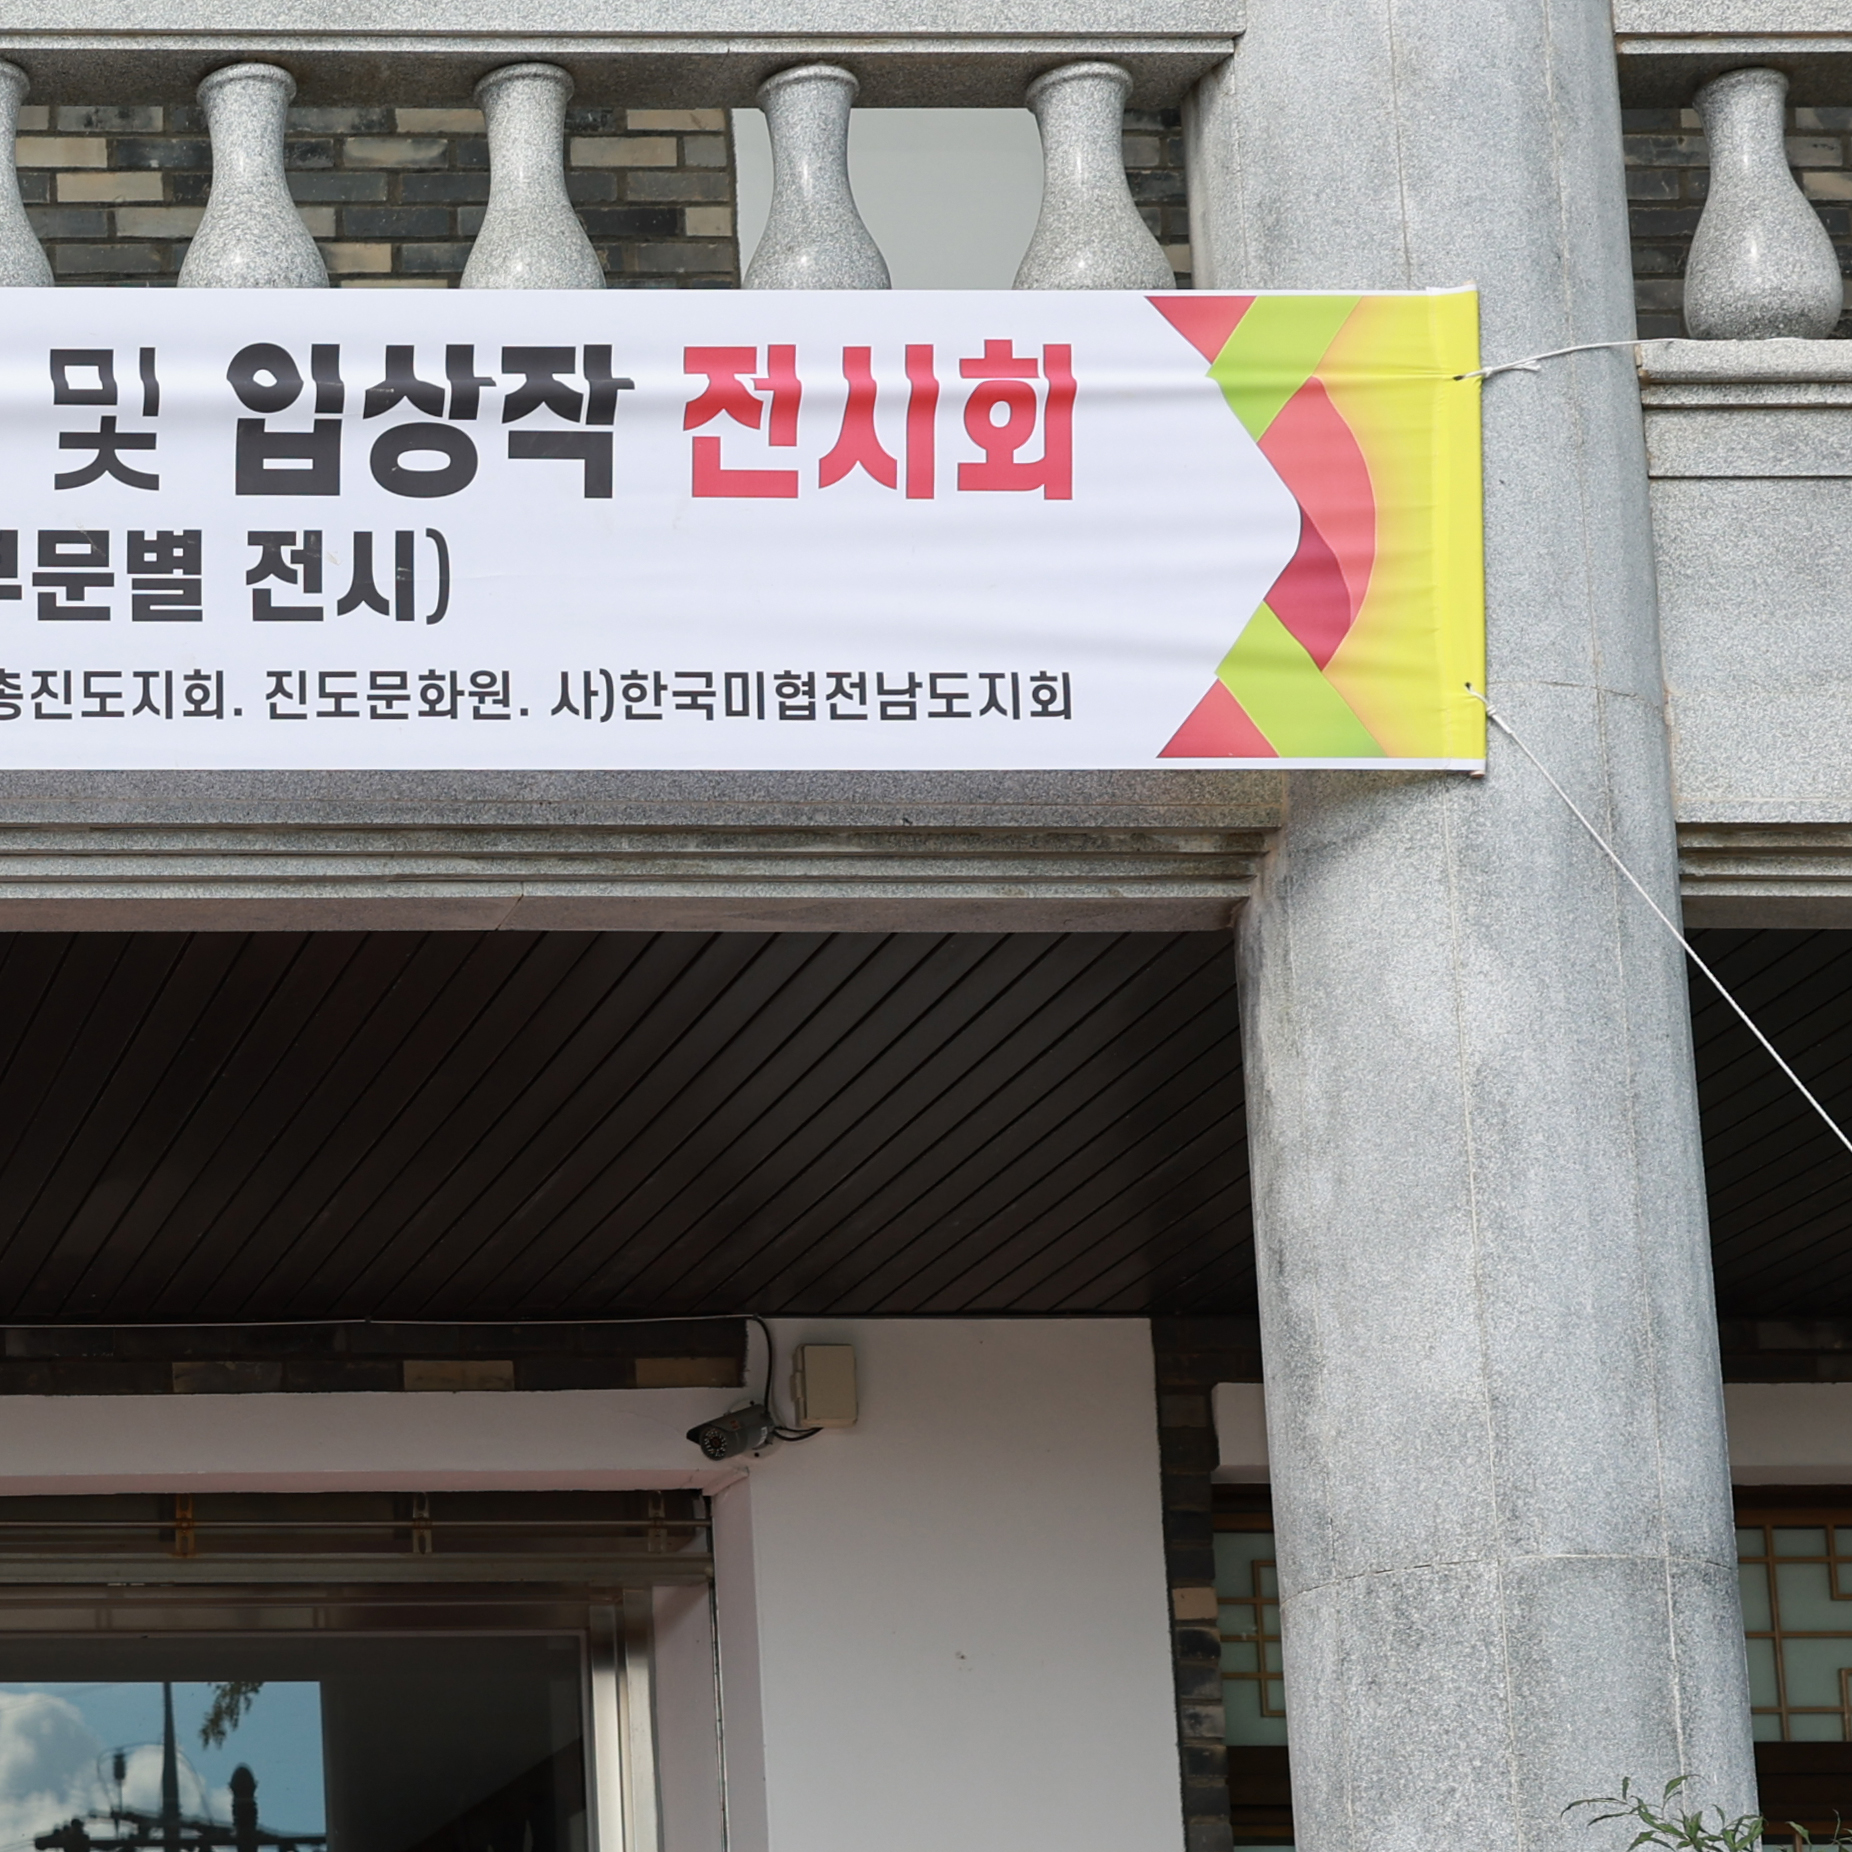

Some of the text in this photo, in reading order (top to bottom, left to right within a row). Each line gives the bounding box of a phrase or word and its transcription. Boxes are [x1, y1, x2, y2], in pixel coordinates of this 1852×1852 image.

[50, 347, 159, 490] 및
[227, 343, 635, 498] 입상작
[683, 340, 1077, 500] 전시회
[246, 527, 449, 625] 전시)
[265, 669, 529, 721] 진도문화원.
[550, 668, 1072, 722] 사)한국미협전남도지회
